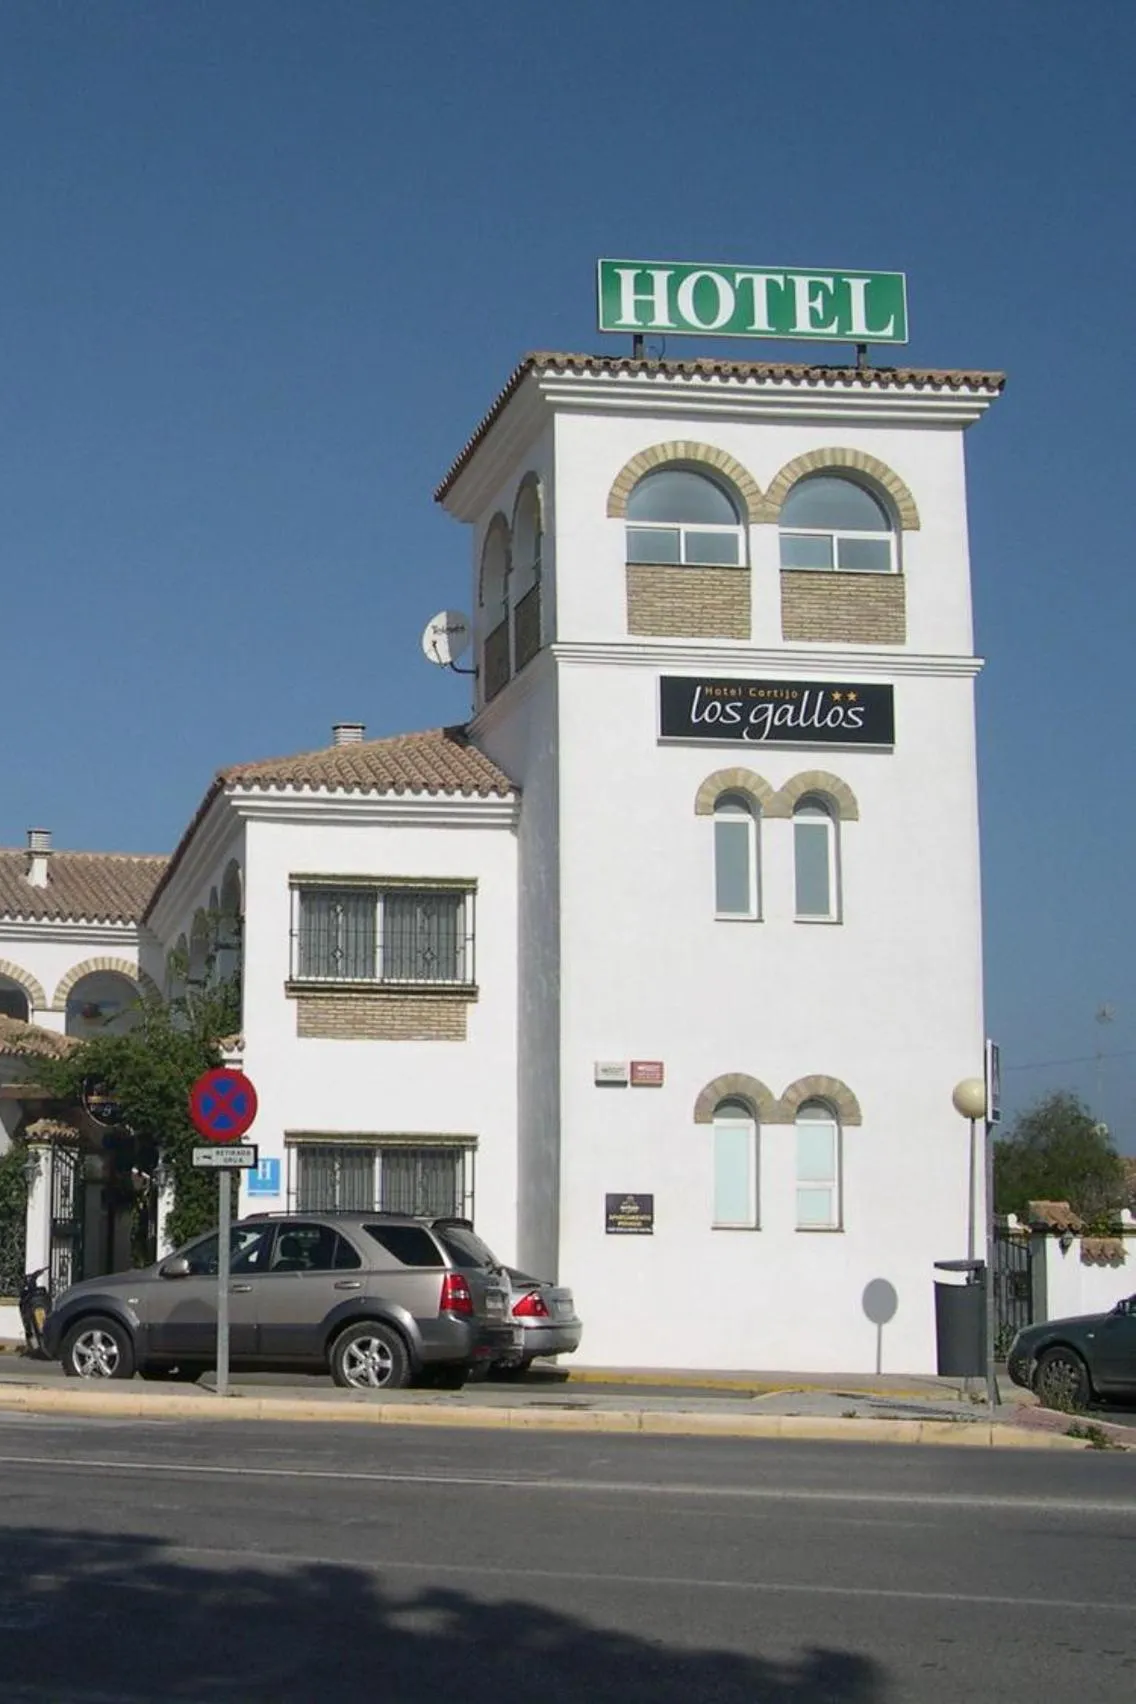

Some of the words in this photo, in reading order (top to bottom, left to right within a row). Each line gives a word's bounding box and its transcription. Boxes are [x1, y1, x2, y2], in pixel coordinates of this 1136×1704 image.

[613, 267, 895, 336] HOTEL
[704, 686, 742, 698] Hotel
[748, 686, 799, 700] Cortijo
[691, 685, 743, 724] los
[743, 690, 865, 740] gallos
[257, 1160, 272, 1180] H
